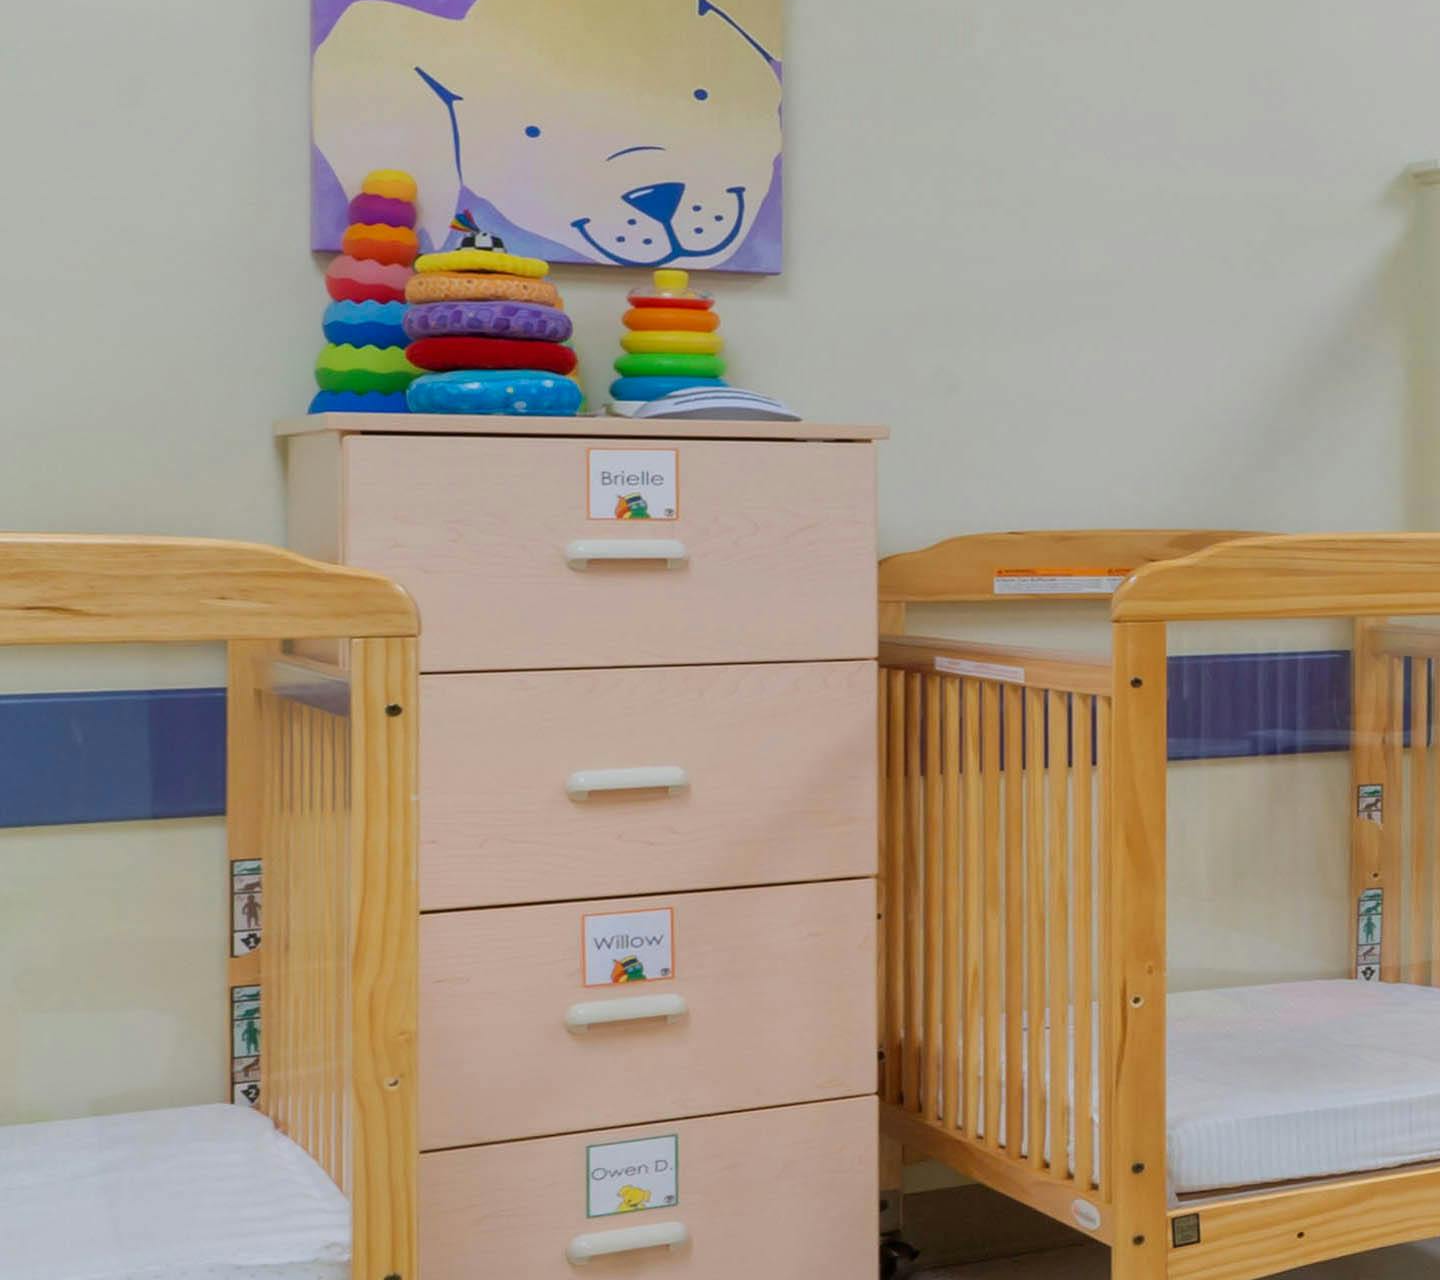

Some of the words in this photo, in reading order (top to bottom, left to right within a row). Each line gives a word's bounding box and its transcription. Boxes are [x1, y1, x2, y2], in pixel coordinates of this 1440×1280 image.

[600, 470, 665, 487] Brielle
[592, 932, 664, 951] Willow
[591, 1162, 649, 1181] Owen
[654, 1158, 673, 1173] D.
